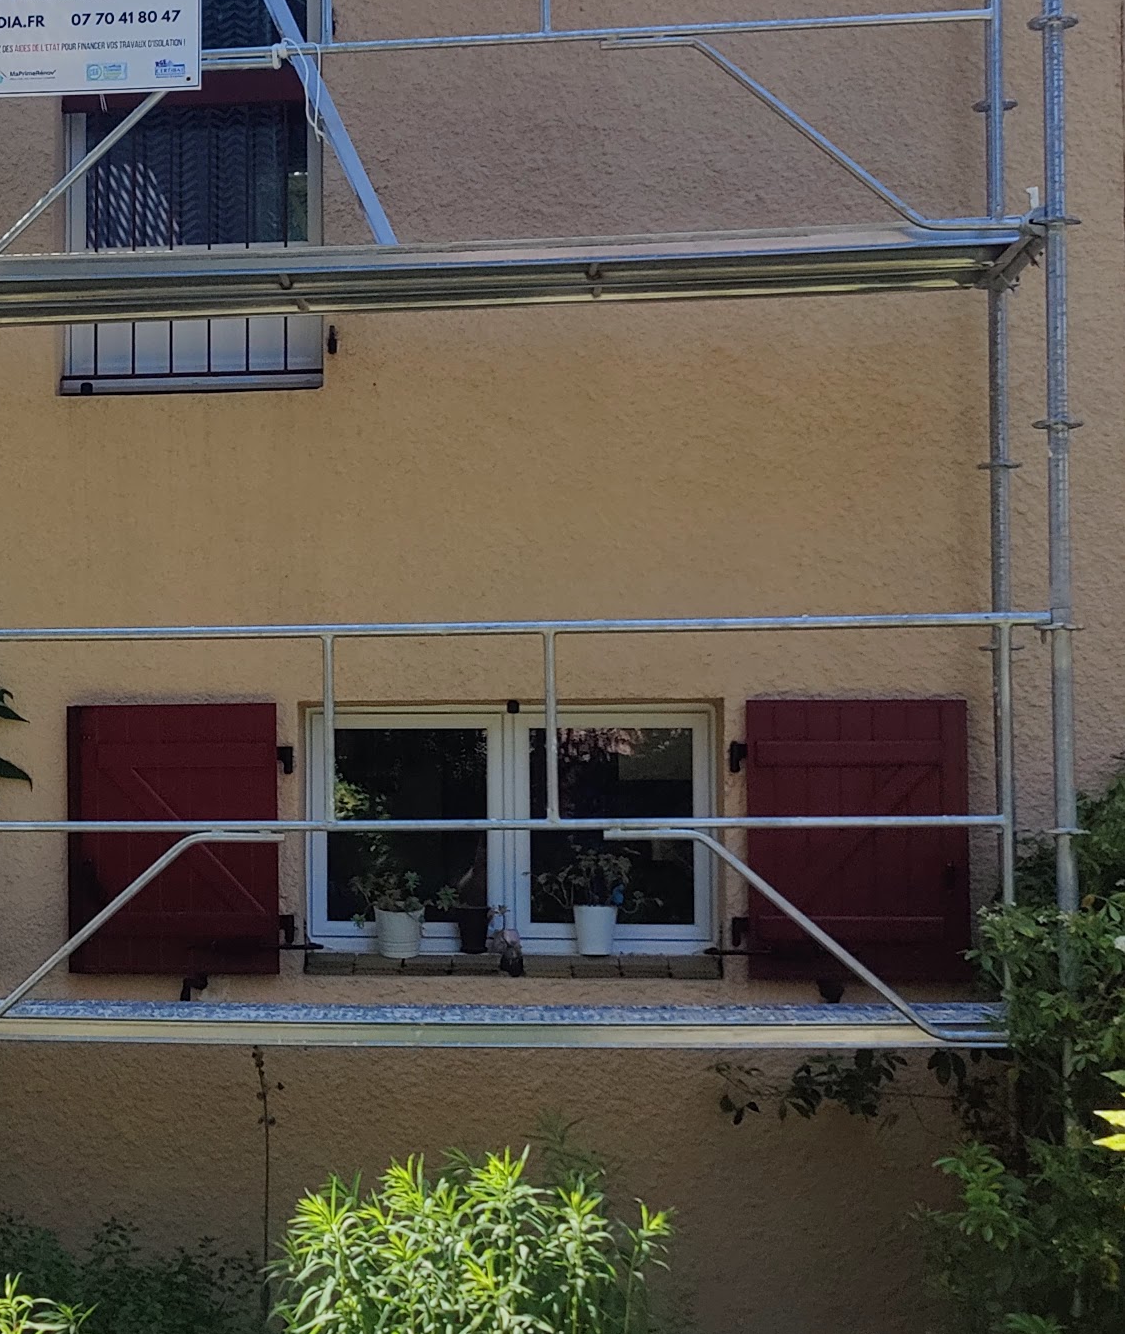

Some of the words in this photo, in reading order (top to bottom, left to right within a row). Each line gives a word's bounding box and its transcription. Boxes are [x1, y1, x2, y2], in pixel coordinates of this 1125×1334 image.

[71, 13, 91, 26] 07
[95, 12, 115, 25] 70
[118, 11, 134, 24] 41
[138, 10, 157, 24] 80
[161, 9, 182, 23] 47
[2, 45, 13, 53] DES
[14, 44, 31, 53] AIDES
[32, 43, 39, 52] DE
[61, 43, 77, 51] POUR
[77, 41, 105, 51] FINANCER
[106, 40, 119, 49] VOS
[119, 40, 147, 49] TRAVAUX
[148, 38, 183, 48] D'ISOLATION
